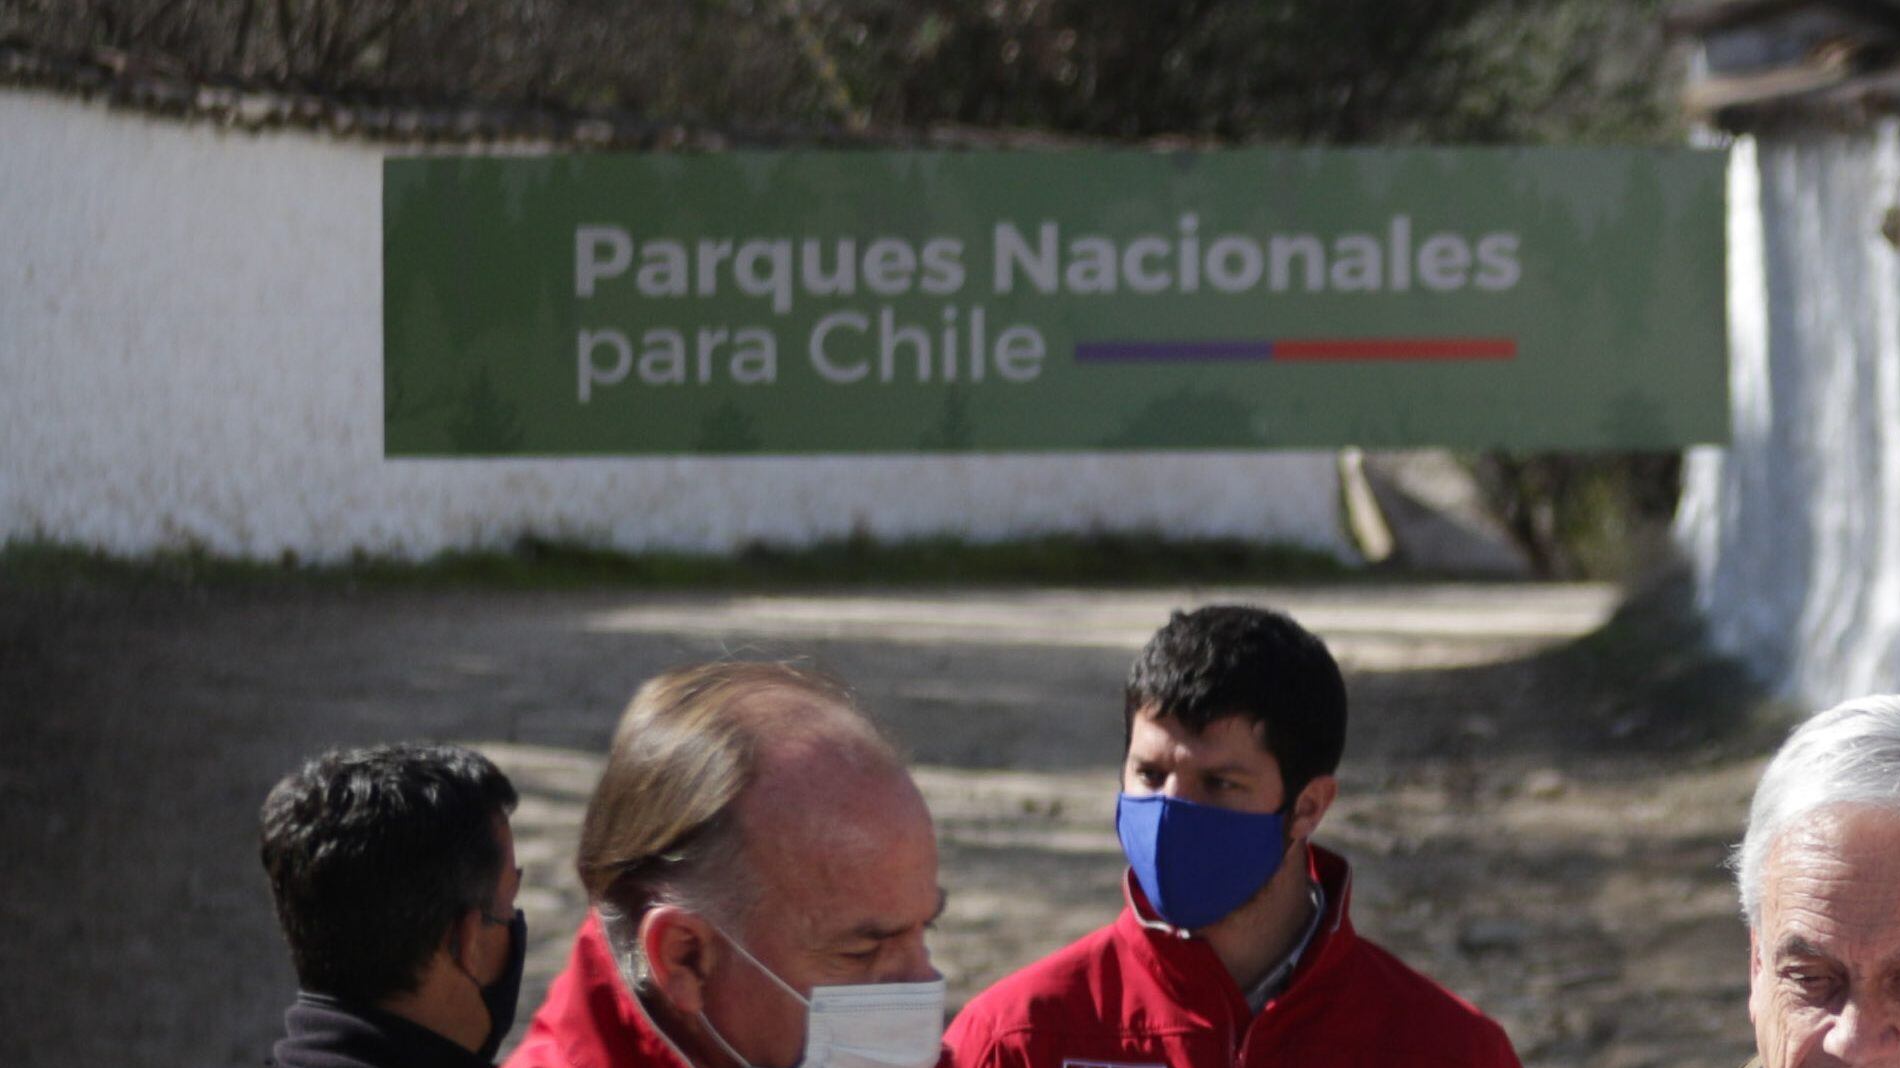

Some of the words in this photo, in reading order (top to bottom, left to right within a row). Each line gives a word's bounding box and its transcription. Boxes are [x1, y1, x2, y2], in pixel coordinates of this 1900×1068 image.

[574, 223, 966, 315] Parques
[993, 212, 1523, 294] Nacionales
[577, 326, 778, 403] para
[808, 305, 1046, 383] Chile
